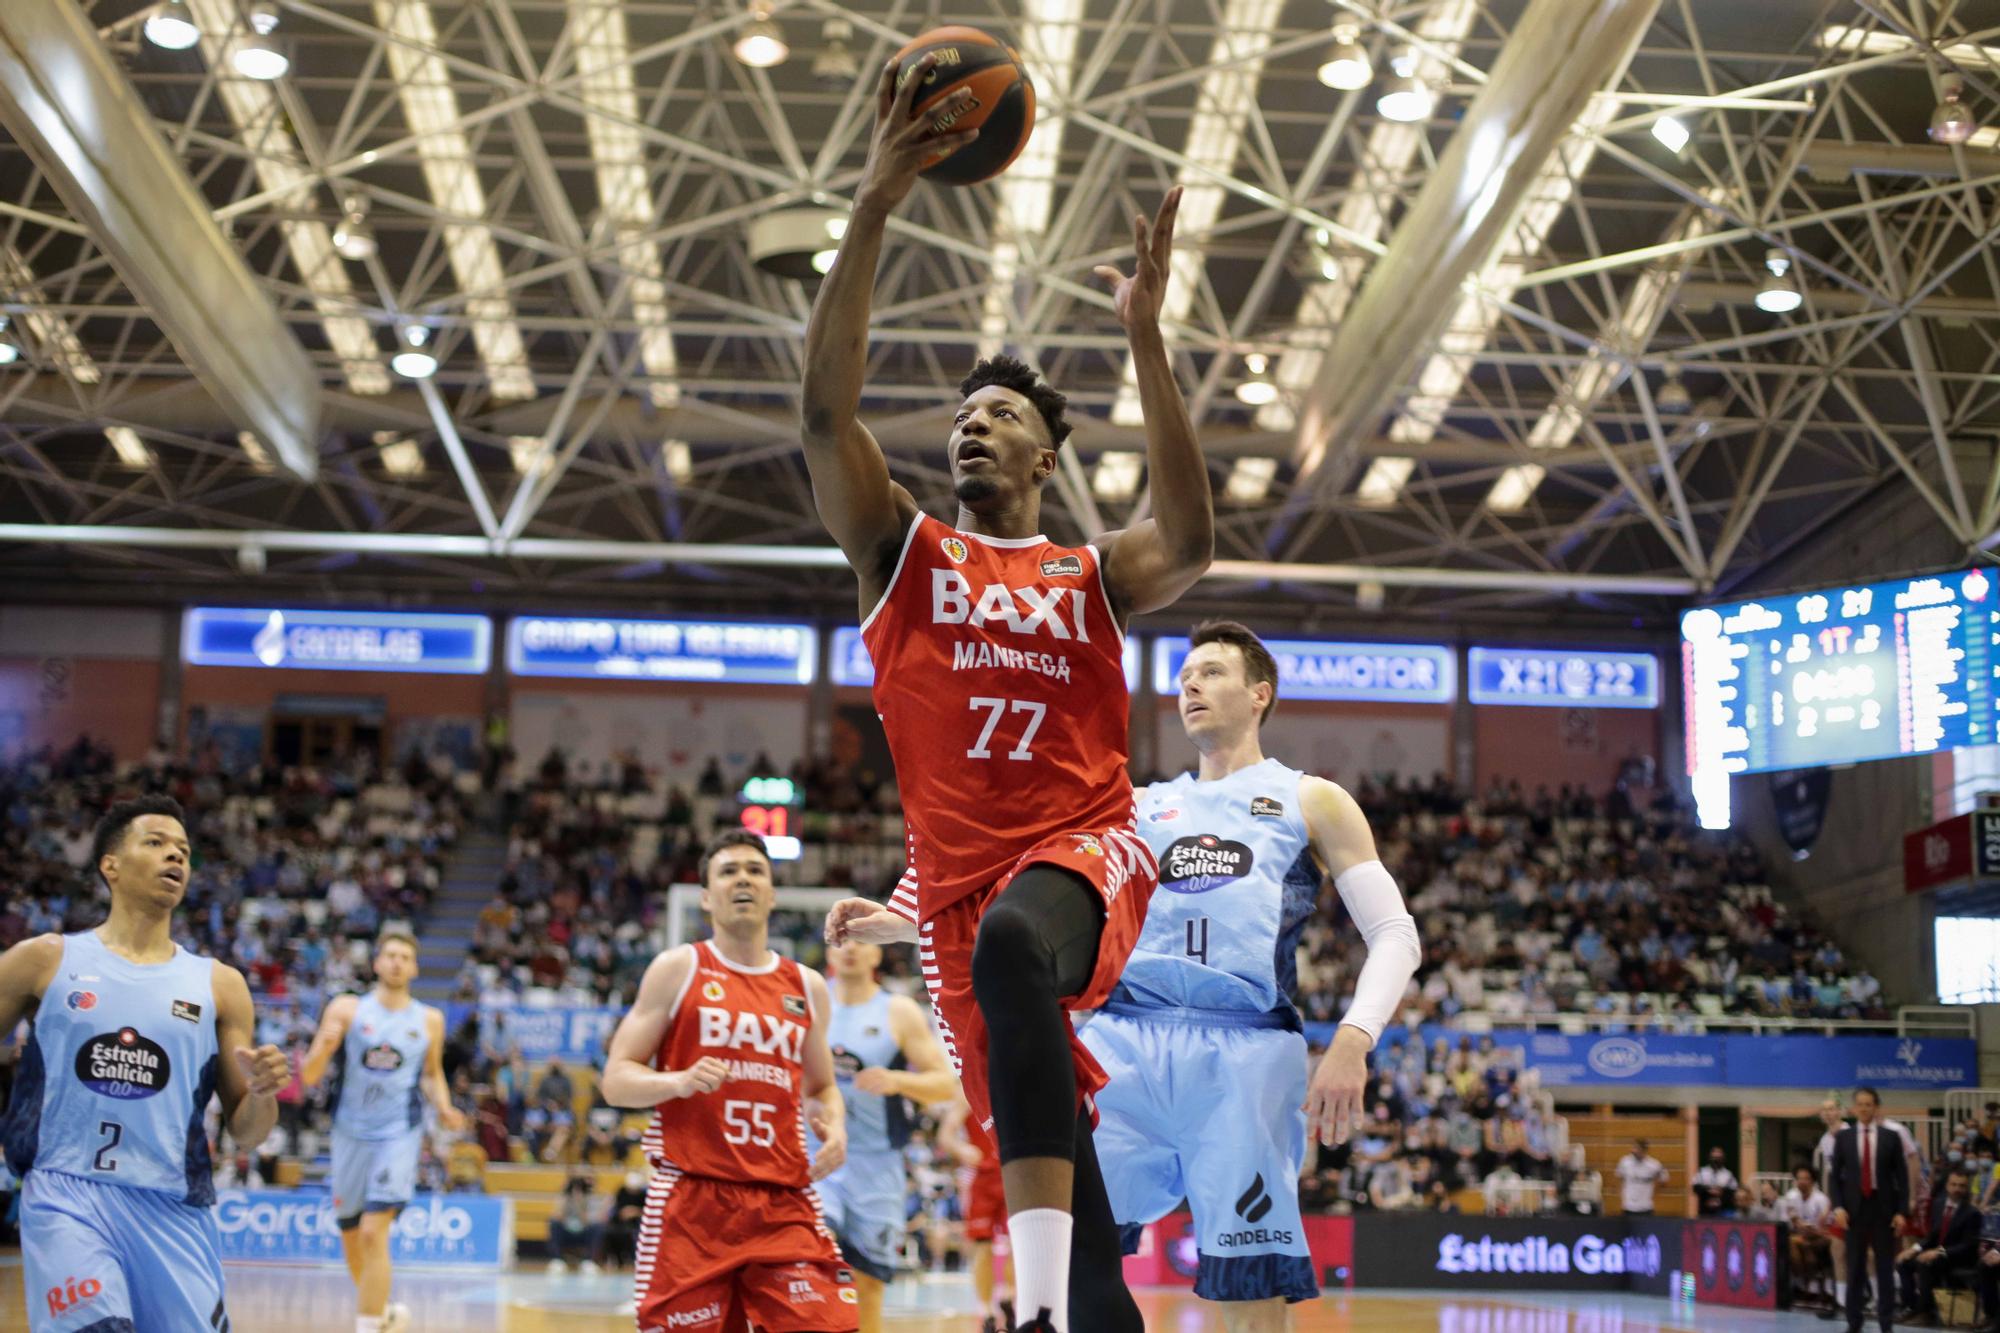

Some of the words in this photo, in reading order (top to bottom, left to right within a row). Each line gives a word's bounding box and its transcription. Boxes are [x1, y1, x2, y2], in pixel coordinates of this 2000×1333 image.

[930, 567, 1091, 643] BAXI
[1276, 654, 1436, 690] RAMOTOR
[967, 696, 1047, 761] 77
[1169, 845, 1241, 864] Estrella
[1169, 860, 1235, 878] Galicia
[1186, 916, 1208, 966] 4
[90, 1042, 160, 1069] Estrella
[698, 1006, 807, 1065] BAXI
[90, 1060, 154, 1085] Galicia
[723, 1099, 777, 1148] 55
[93, 1121, 122, 1171] 2
[389, 1196, 473, 1240] elo
[1217, 1228, 1294, 1248] CANDELAS
[1436, 1233, 1571, 1274] Estrella
[46, 1276, 103, 1319] Río
